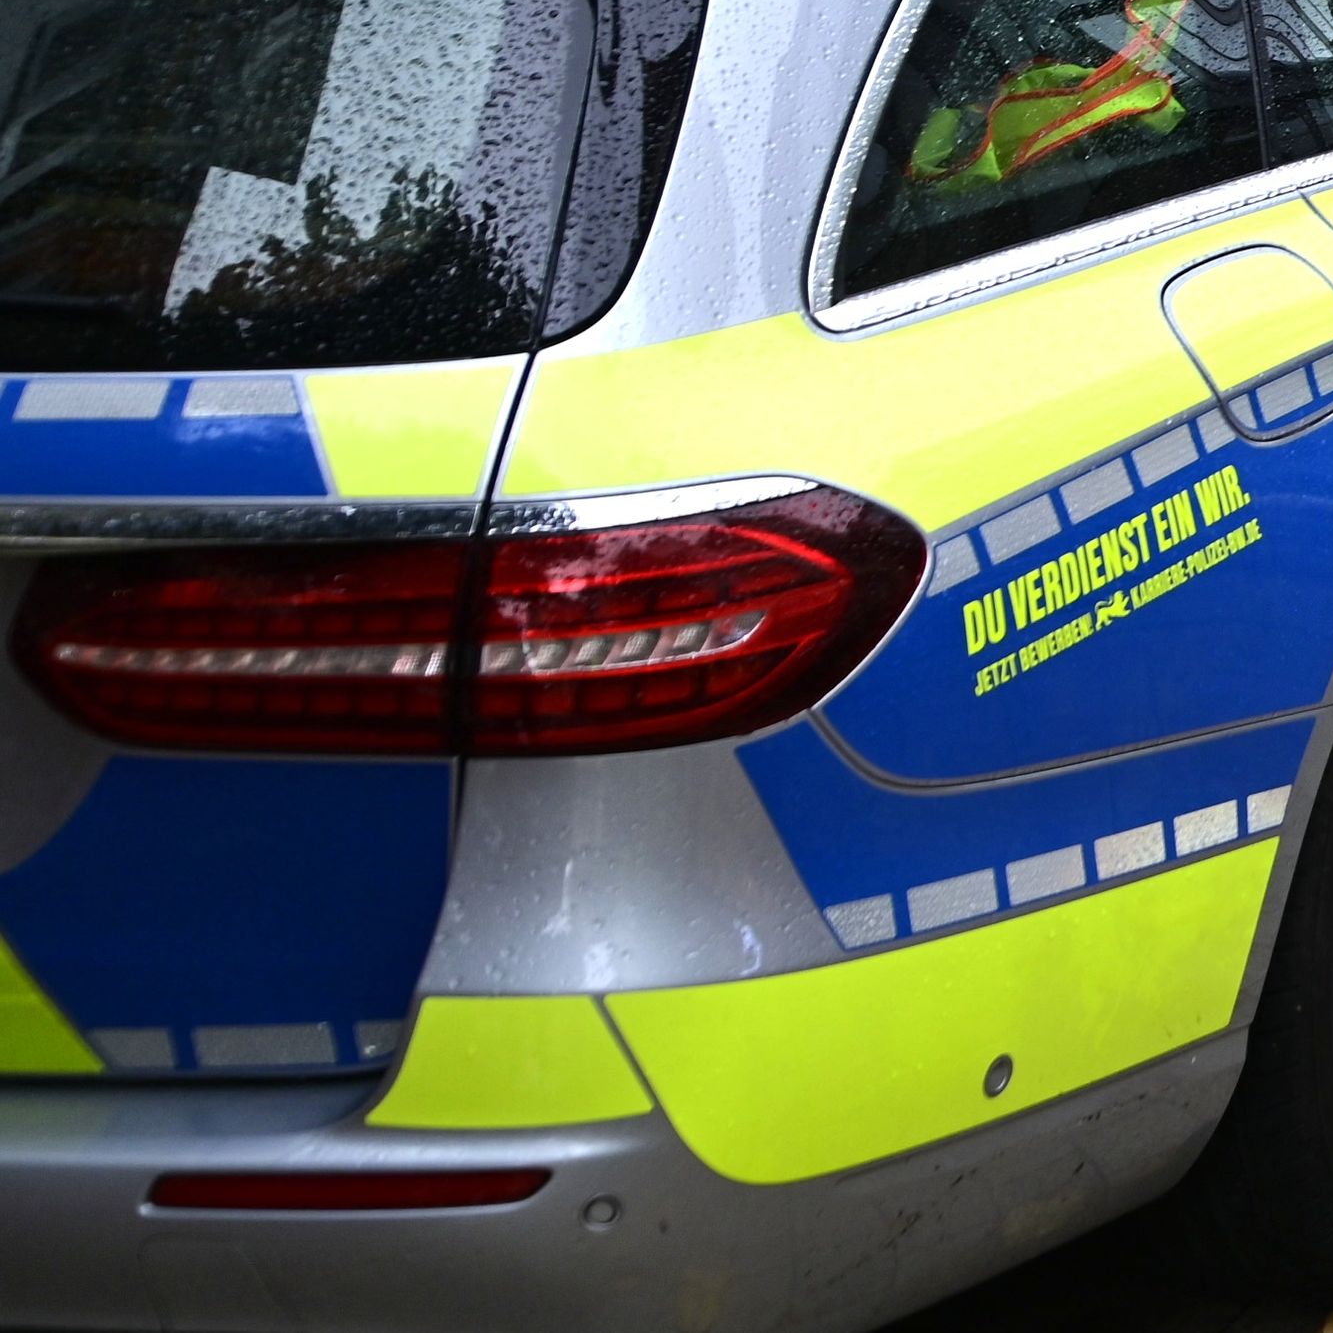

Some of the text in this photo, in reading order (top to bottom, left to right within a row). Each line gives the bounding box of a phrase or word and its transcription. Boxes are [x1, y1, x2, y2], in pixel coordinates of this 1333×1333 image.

[963, 464, 1251, 657] DU VERDIENST EIN WIR.
[974, 652, 1019, 697] JETZT
